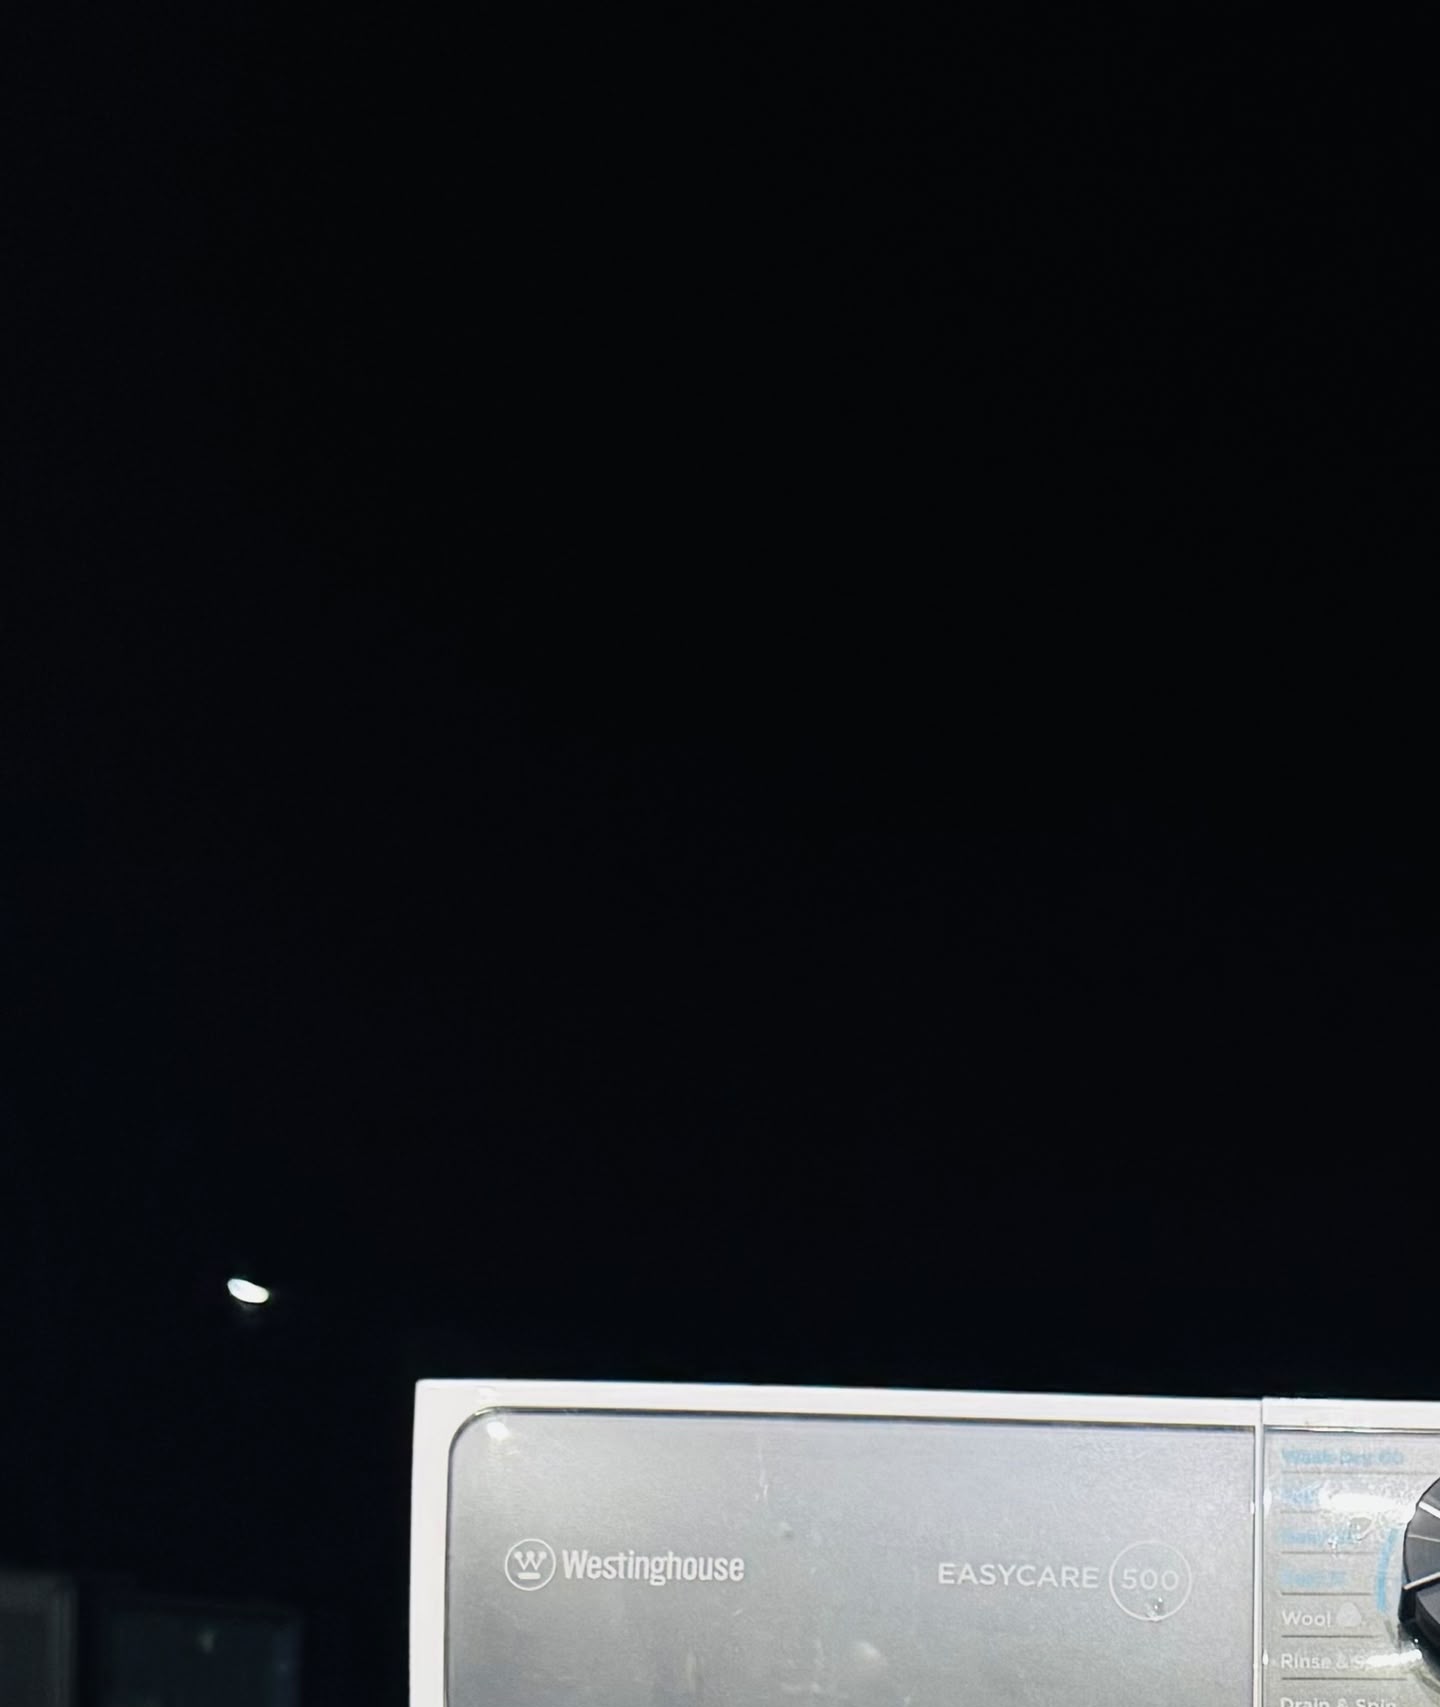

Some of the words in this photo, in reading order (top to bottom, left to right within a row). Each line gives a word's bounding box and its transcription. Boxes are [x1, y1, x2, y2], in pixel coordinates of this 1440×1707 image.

[561, 1550, 745, 1586] Westinghouse
[937, 1562, 1100, 1589] EASYCARE
[1120, 1568, 1180, 1591] 500
[1281, 1611, 1332, 1627] Wool
[1280, 1653, 1332, 1669] Rinse
[1336, 1655, 1350, 1670] &
